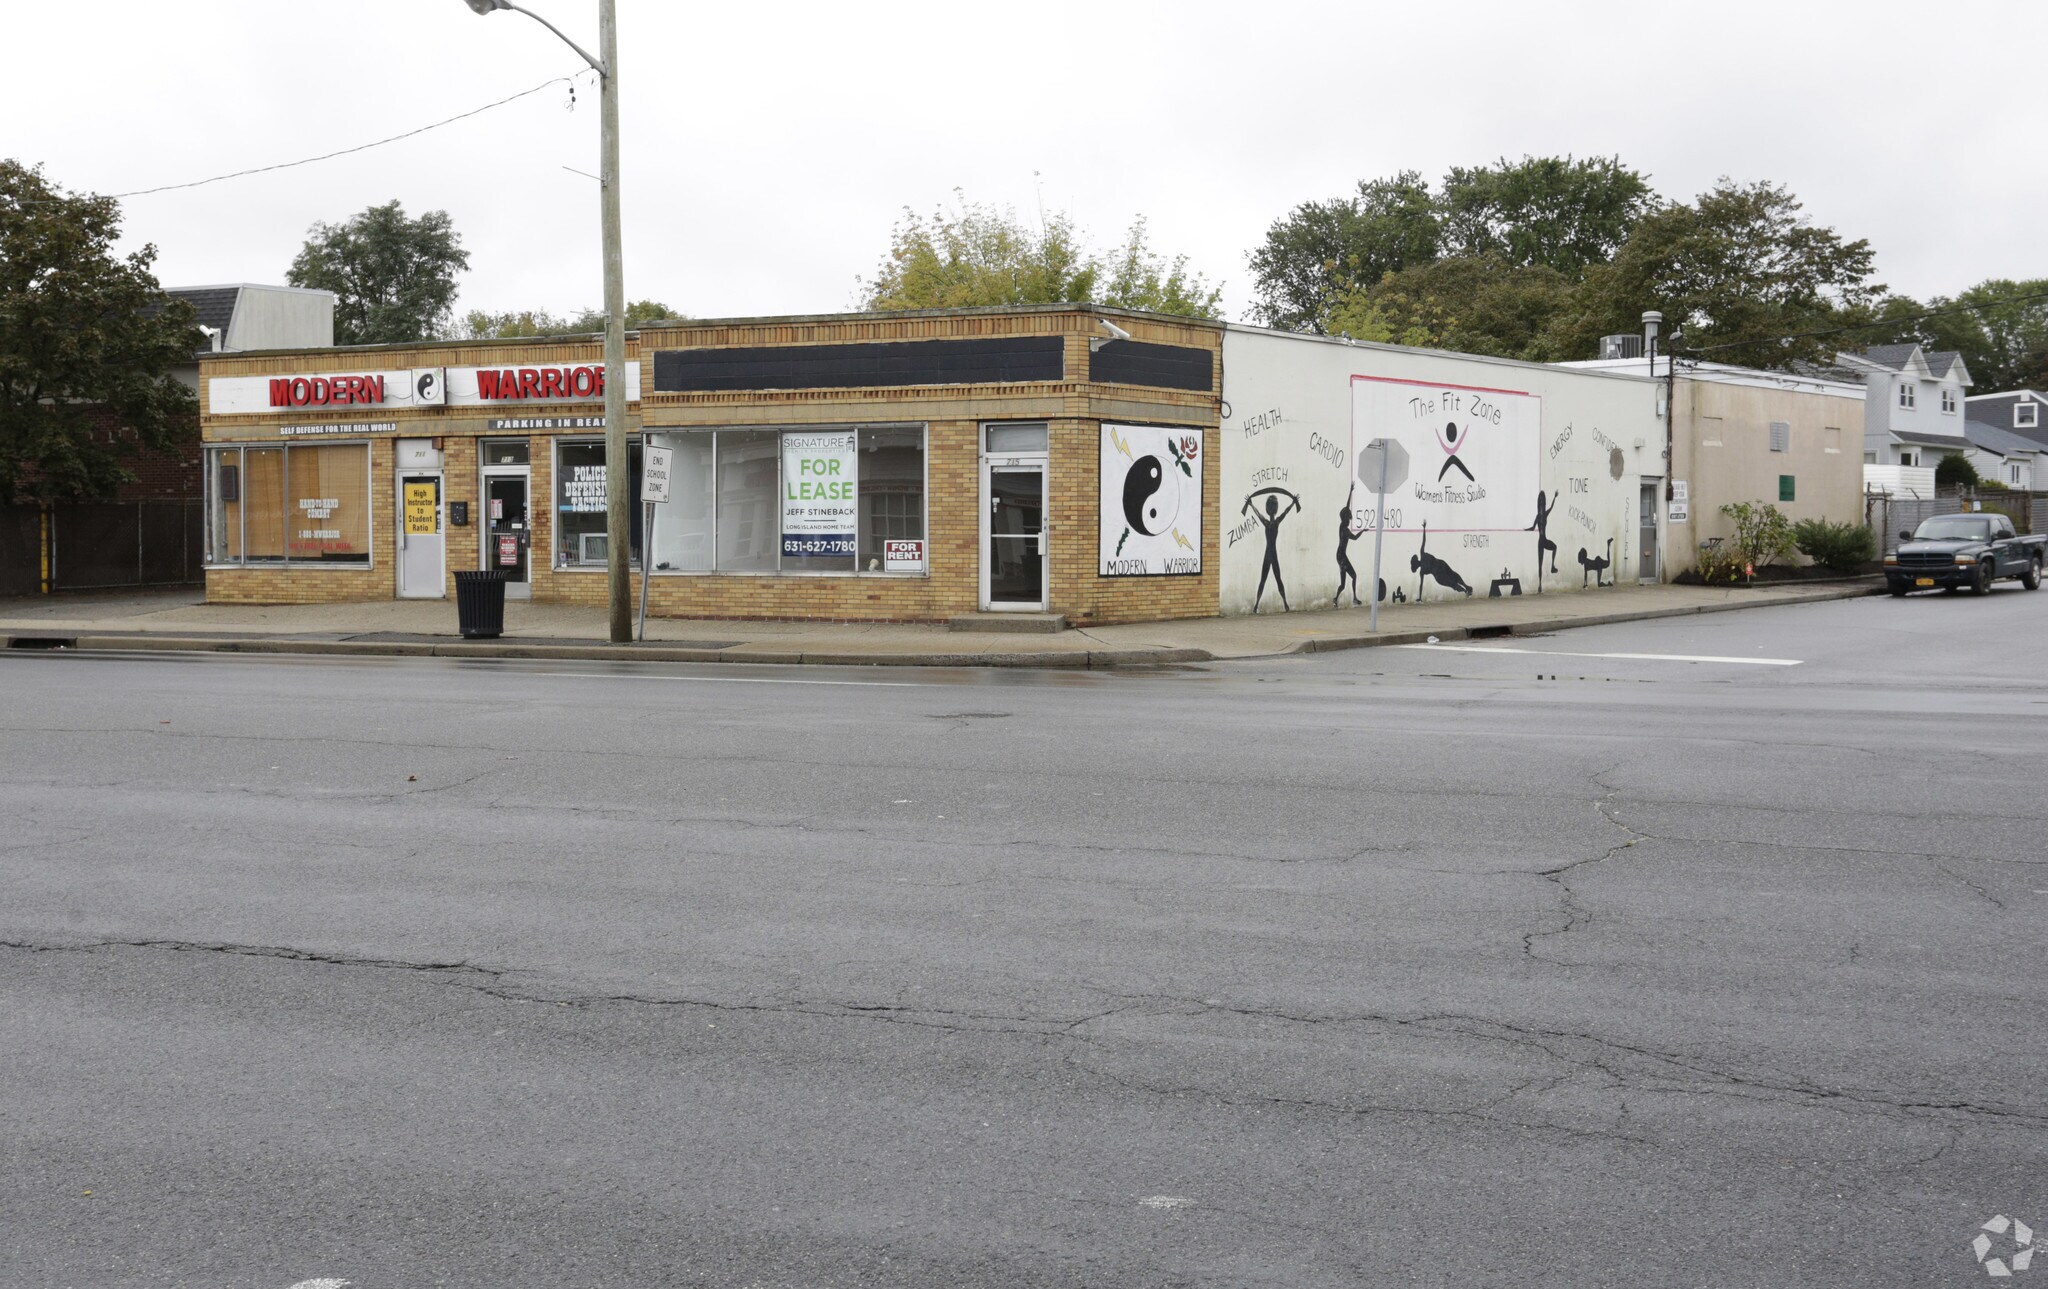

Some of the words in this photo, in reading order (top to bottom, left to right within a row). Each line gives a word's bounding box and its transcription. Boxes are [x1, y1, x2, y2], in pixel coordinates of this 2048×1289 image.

[269, 374, 384, 407] MODERN
[1408, 397, 1435, 419] The
[1442, 392, 1461, 411] Fit
[1470, 395, 1501, 425] Zone
[280, 427, 295, 435] SELF
[296, 425, 324, 434] DEFENSE
[325, 425, 339, 433] FOR
[340, 424, 352, 432] THE
[353, 424, 370, 432] REAL
[370, 423, 396, 431] WORLD
[497, 418, 552, 429] PARKING
[558, 418, 571, 427] IN
[577, 418, 606, 427] REA
[1243, 407, 1283, 439] HEALTH
[783, 438, 845, 448] SIGNATURE
[1550, 421, 1573, 460] ENERGY
[1309, 431, 1345, 469] CARDIO
[652, 456, 663, 466] END
[801, 459, 841, 476] FOR
[574, 466, 607, 481] POLICE
[646, 469, 667, 480] SCHOOL
[1251, 467, 1288, 488] STRETCH
[565, 482, 607, 497] DEFENSI
[649, 482, 662, 492] ZONE
[788, 482, 854, 500] LEASE
[1569, 477, 1589, 493] TONE
[413, 489, 427, 498] High
[786, 508, 805, 516] JEFF
[808, 508, 855, 516] STINEBACK
[1227, 515, 1259, 549] ZUMBA
[784, 540, 856, 552] 631-627-1780
[891, 543, 917, 551] FOR
[1463, 534, 1490, 549] STRENGTH
[887, 551, 921, 560] RENT
[1107, 559, 1147, 575] MODERN
[1163, 558, 1199, 574] WARRIOR
